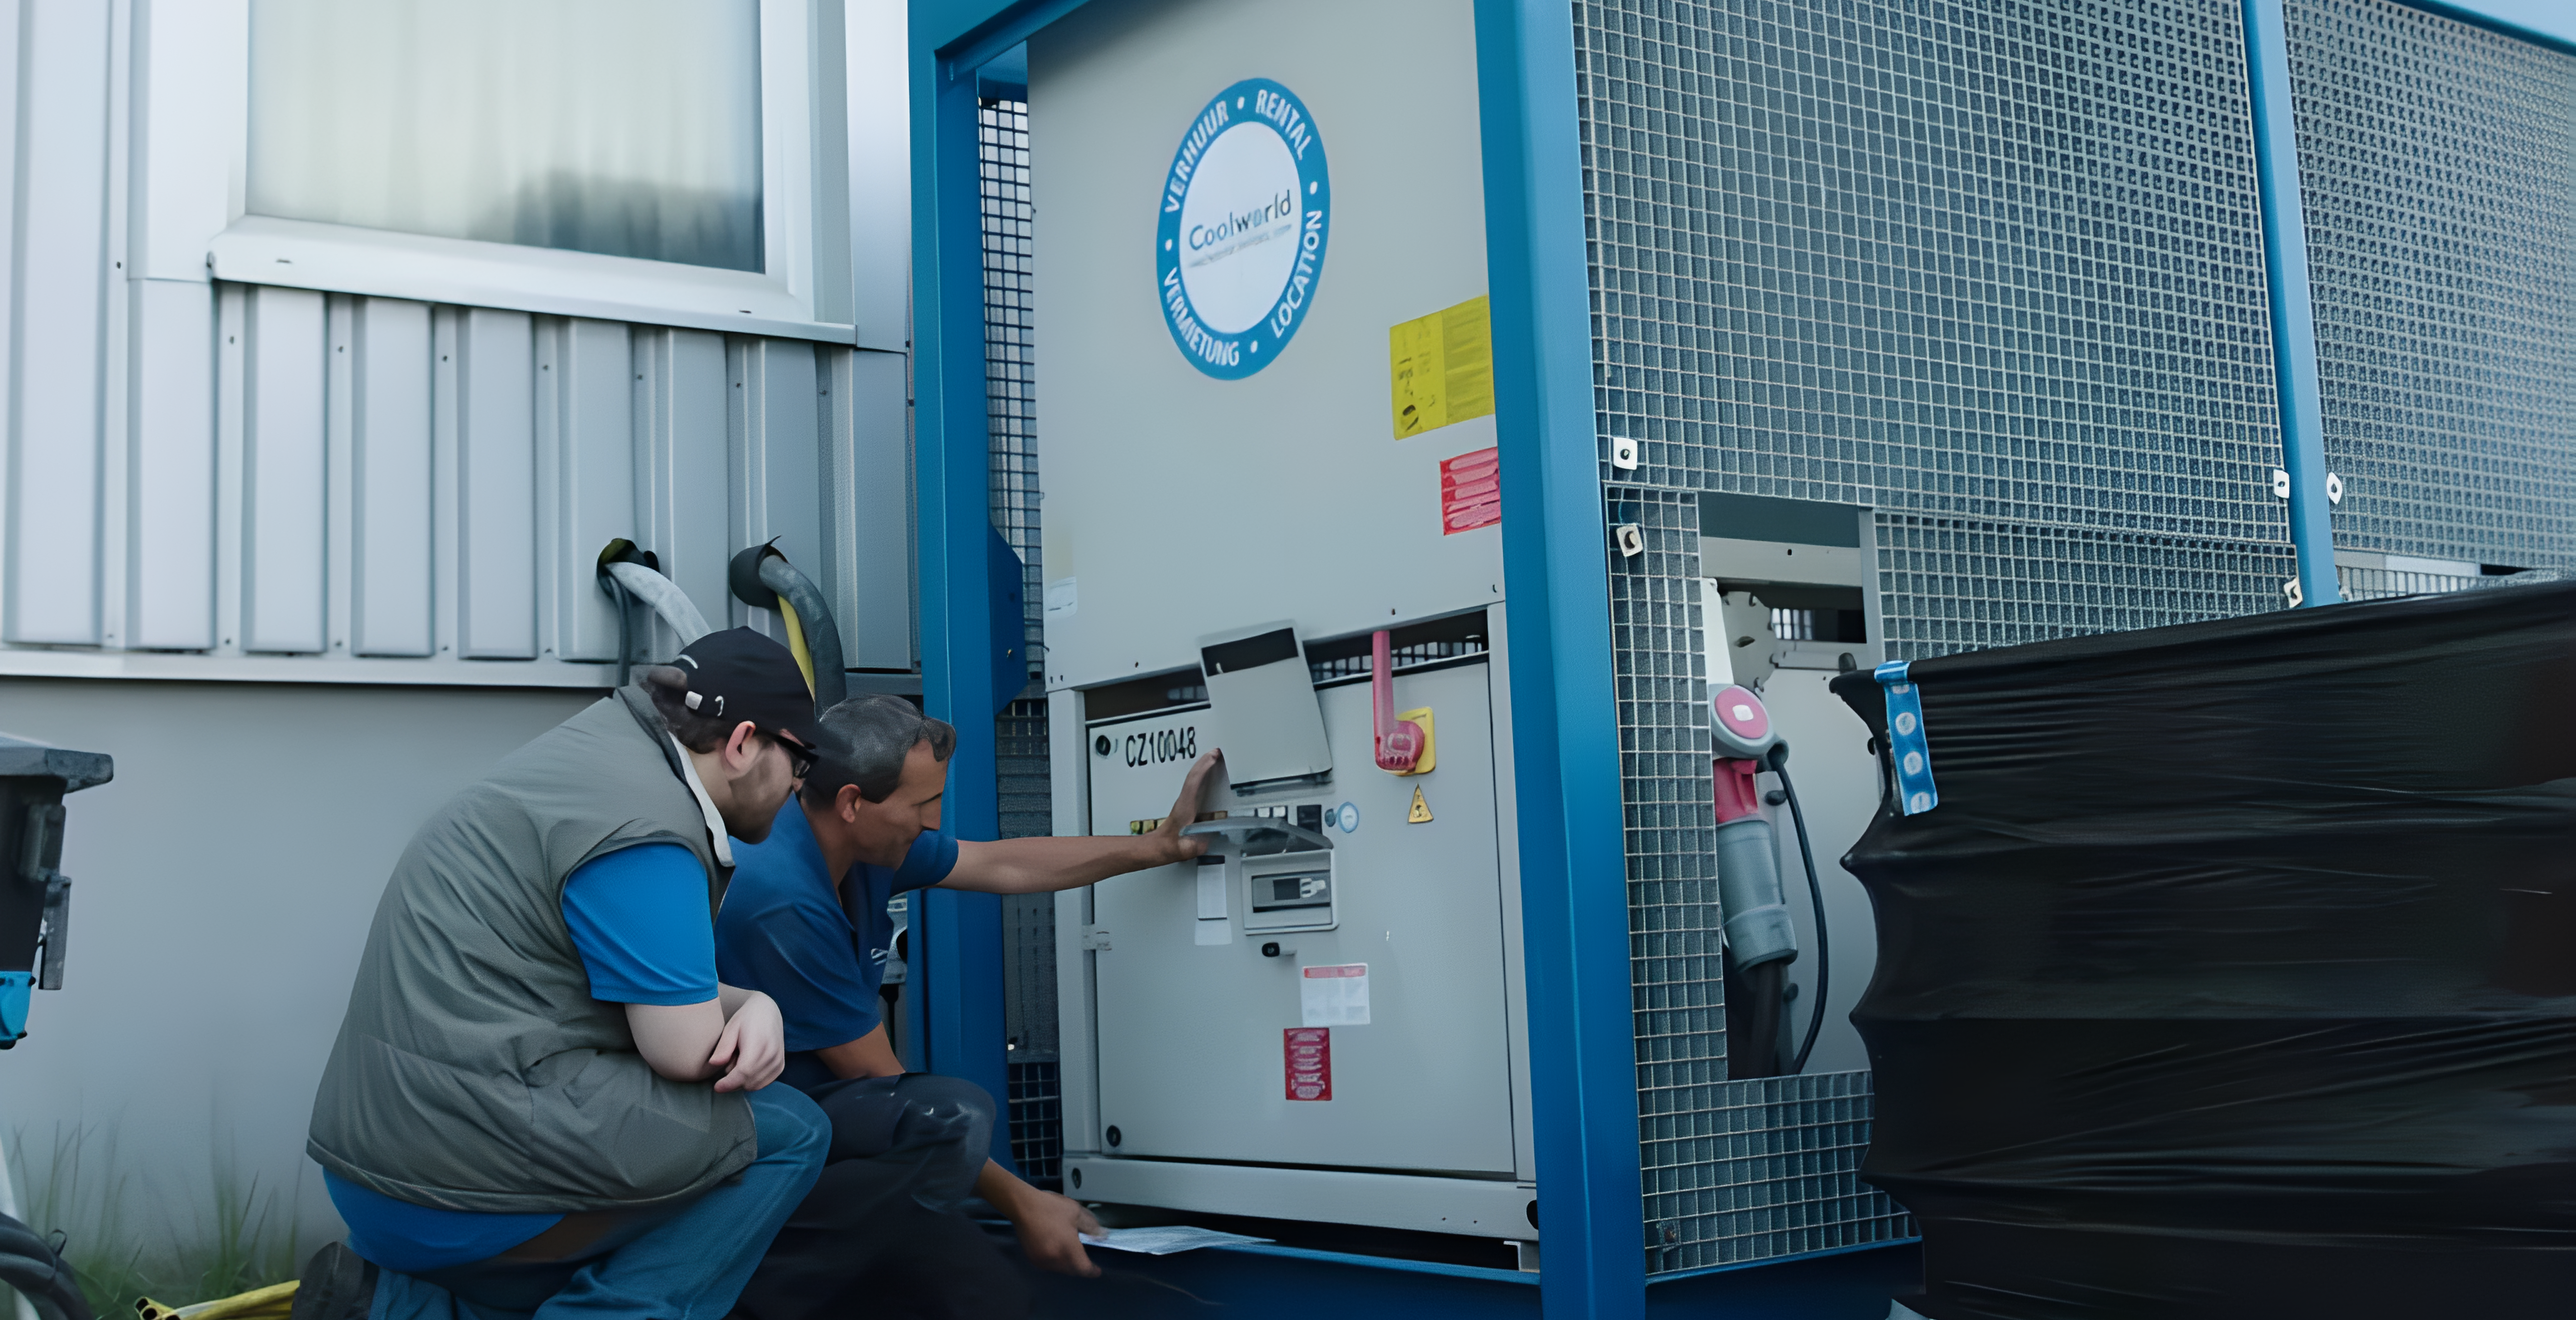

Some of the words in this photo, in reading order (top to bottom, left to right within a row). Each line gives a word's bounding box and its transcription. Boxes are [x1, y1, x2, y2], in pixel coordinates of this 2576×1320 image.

[1165, 101, 1229, 213] VERHUUR
[1256, 89, 1311, 160] RENTAL
[1189, 189, 1291, 250] Coolworld
[1164, 267, 1239, 366] VERMIETUNG
[1271, 210, 1322, 338] LOCATION
[1126, 726, 1196, 768] CZ10048
